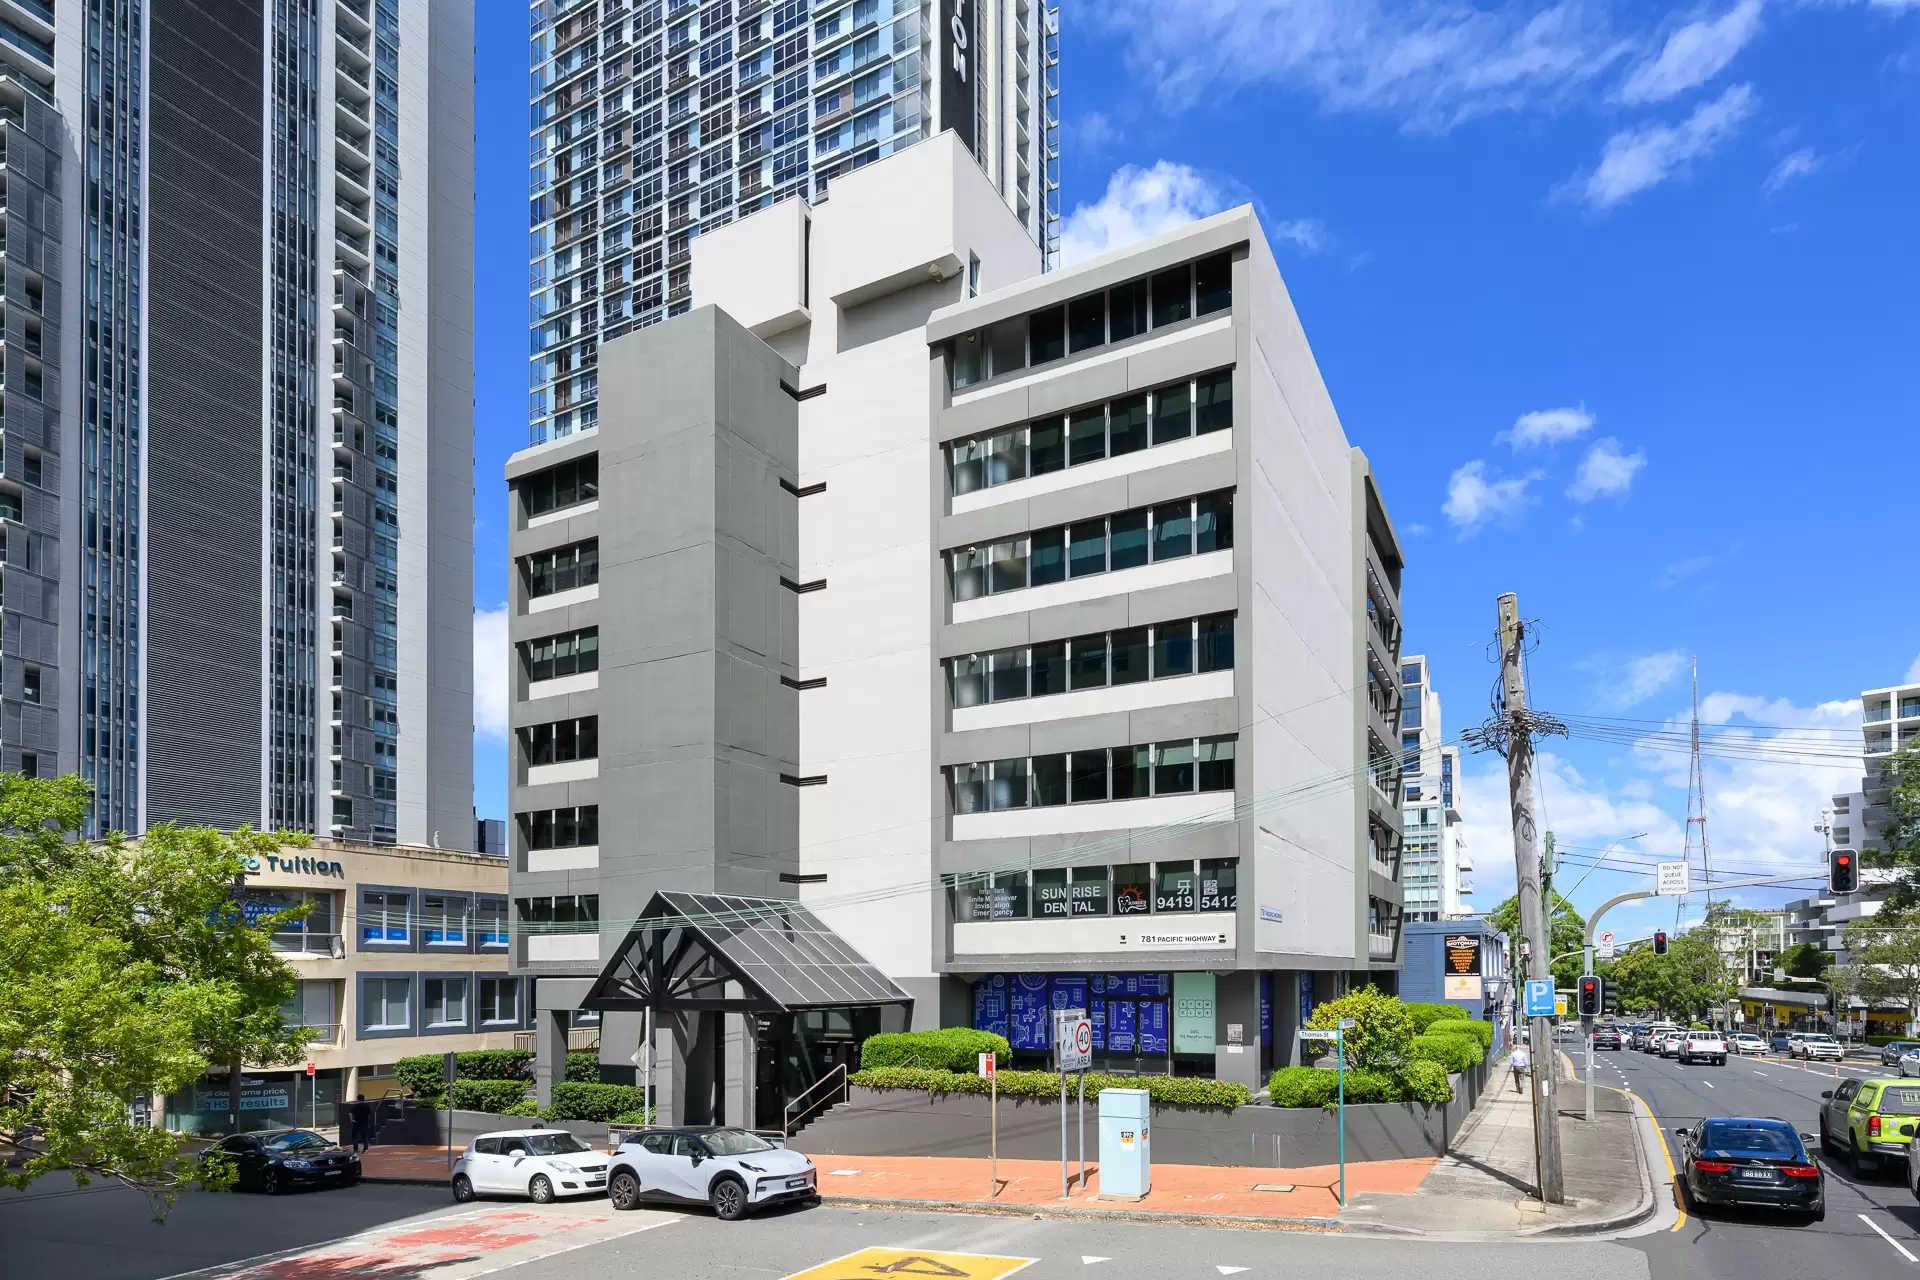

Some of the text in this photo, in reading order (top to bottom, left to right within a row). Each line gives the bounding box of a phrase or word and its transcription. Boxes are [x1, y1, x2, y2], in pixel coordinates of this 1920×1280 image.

[266, 855, 342, 873] Tuition
[1157, 895, 1237, 908] 9419 5412
[1531, 983, 1548, 1003] P
[1079, 1031, 1089, 1045] 40
[1077, 1055, 1090, 1066] AREA
[263, 1088, 288, 1098] price.
[197, 1100, 210, 1111] Big
[241, 1098, 286, 1108] results
